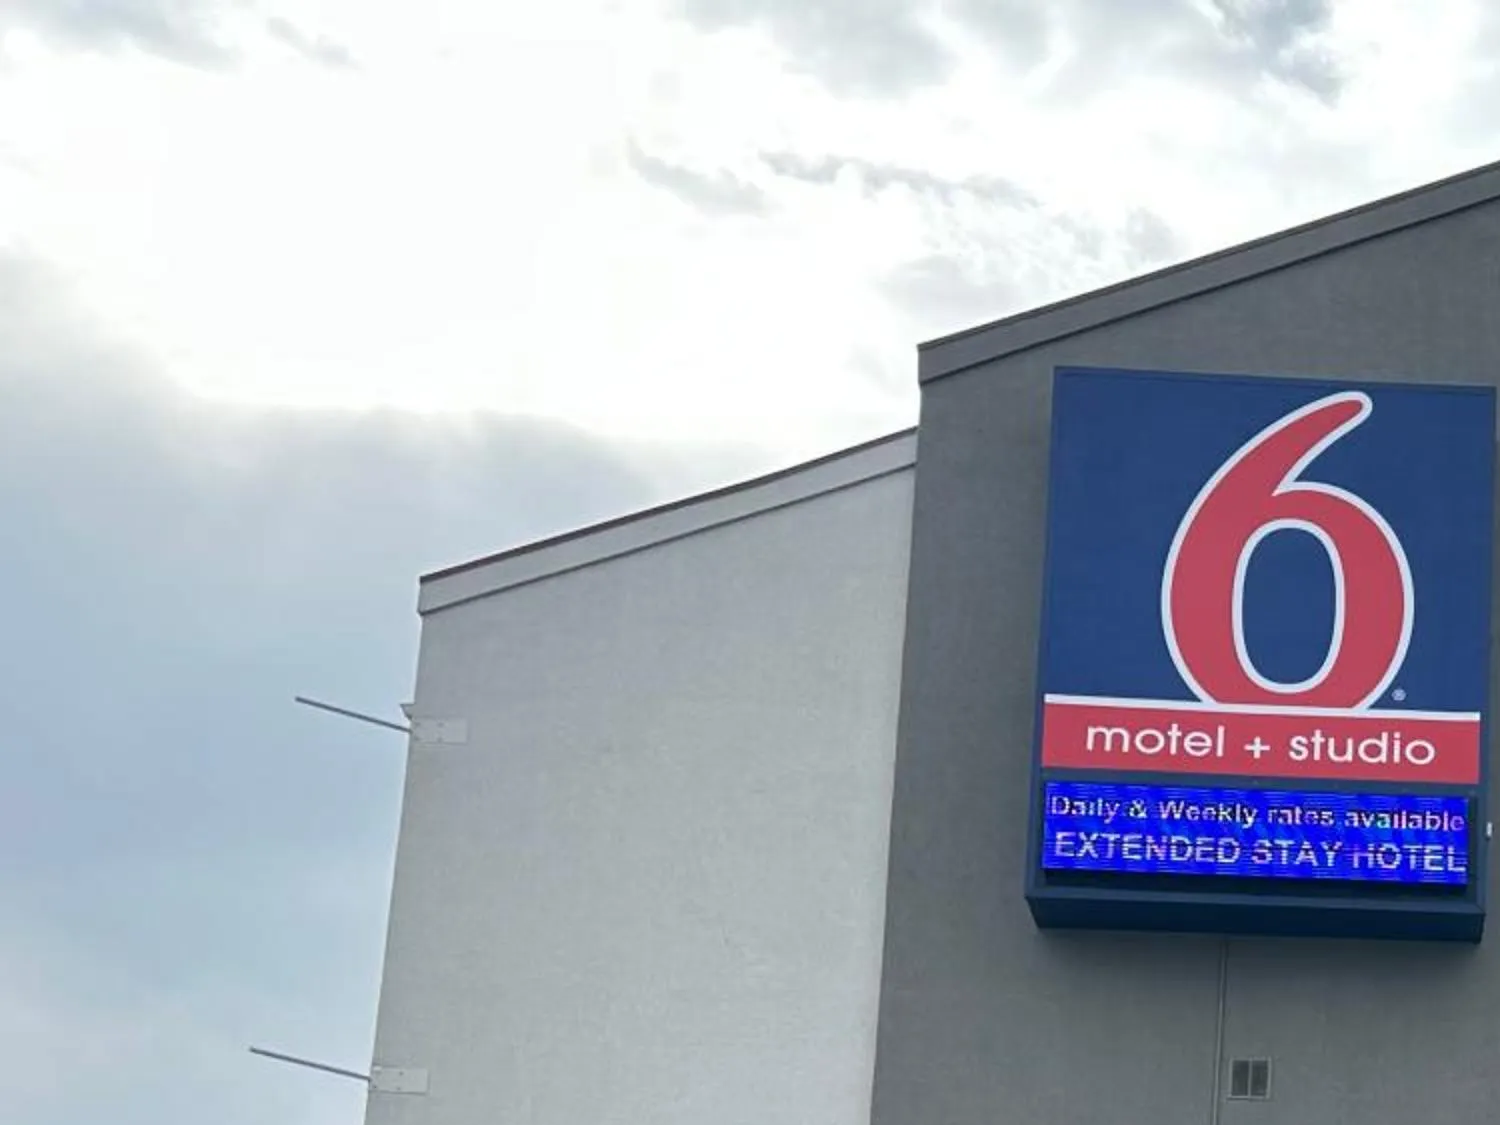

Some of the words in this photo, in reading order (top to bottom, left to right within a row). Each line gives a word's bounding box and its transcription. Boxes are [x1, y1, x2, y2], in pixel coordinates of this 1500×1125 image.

[1161, 391, 1414, 711] 6
[1086, 724, 1224, 757] motel
[1244, 736, 1270, 759] +
[1288, 730, 1435, 766] studio
[1051, 796, 1120, 823] Daily
[1129, 800, 1148, 818] &
[1159, 800, 1258, 828] Weekly
[1268, 806, 1334, 826] rates
[1345, 811, 1464, 832] available
[1055, 832, 1240, 863] EXTENDED
[1251, 839, 1342, 867] STAY
[1353, 843, 1466, 872] HOTEL
